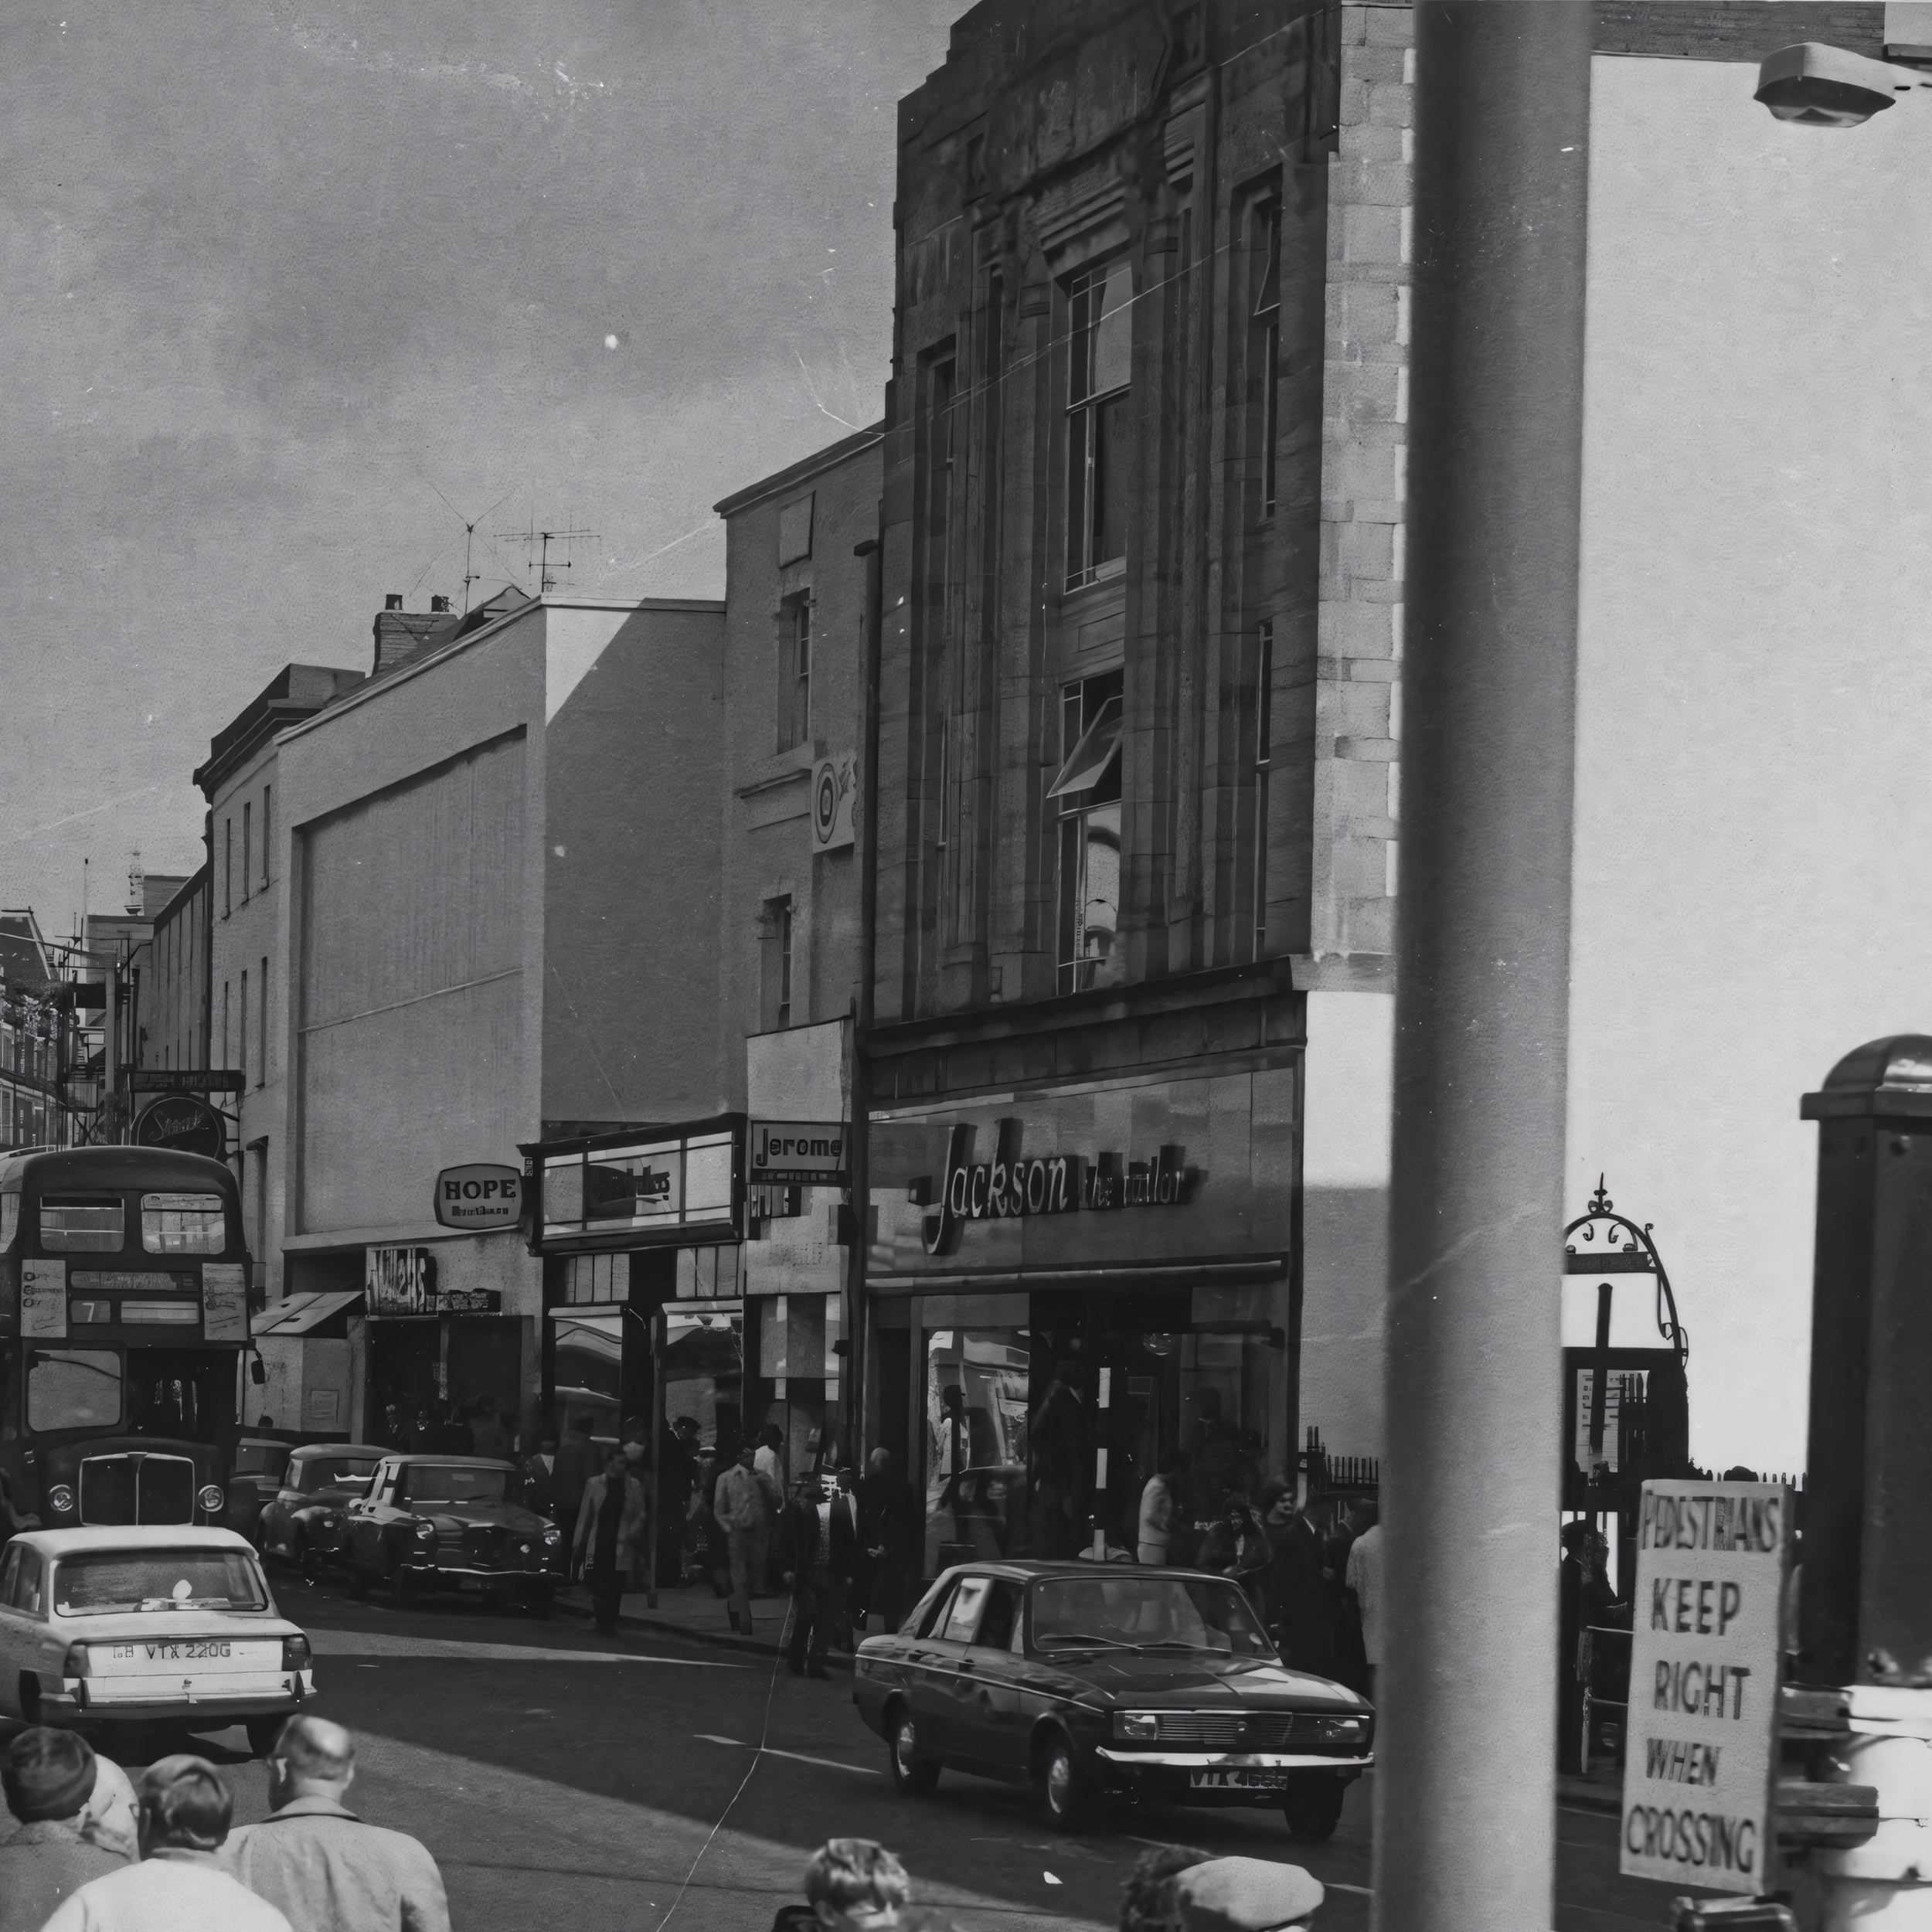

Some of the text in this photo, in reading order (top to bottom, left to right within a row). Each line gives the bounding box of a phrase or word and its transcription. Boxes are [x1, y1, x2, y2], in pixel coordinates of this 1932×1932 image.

[756, 1128, 843, 1167] Jerome
[444, 1179, 517, 1200] HOPE
[927, 1120, 1068, 1254] Jackson
[81, 1302, 96, 1322] 7
[1651, 1577, 1740, 1636] KEEP
[1654, 1660, 1751, 1719] RIGHT
[1645, 1738, 1720, 1787] WHEN
[1626, 1804, 1757, 1873] CROSSING
